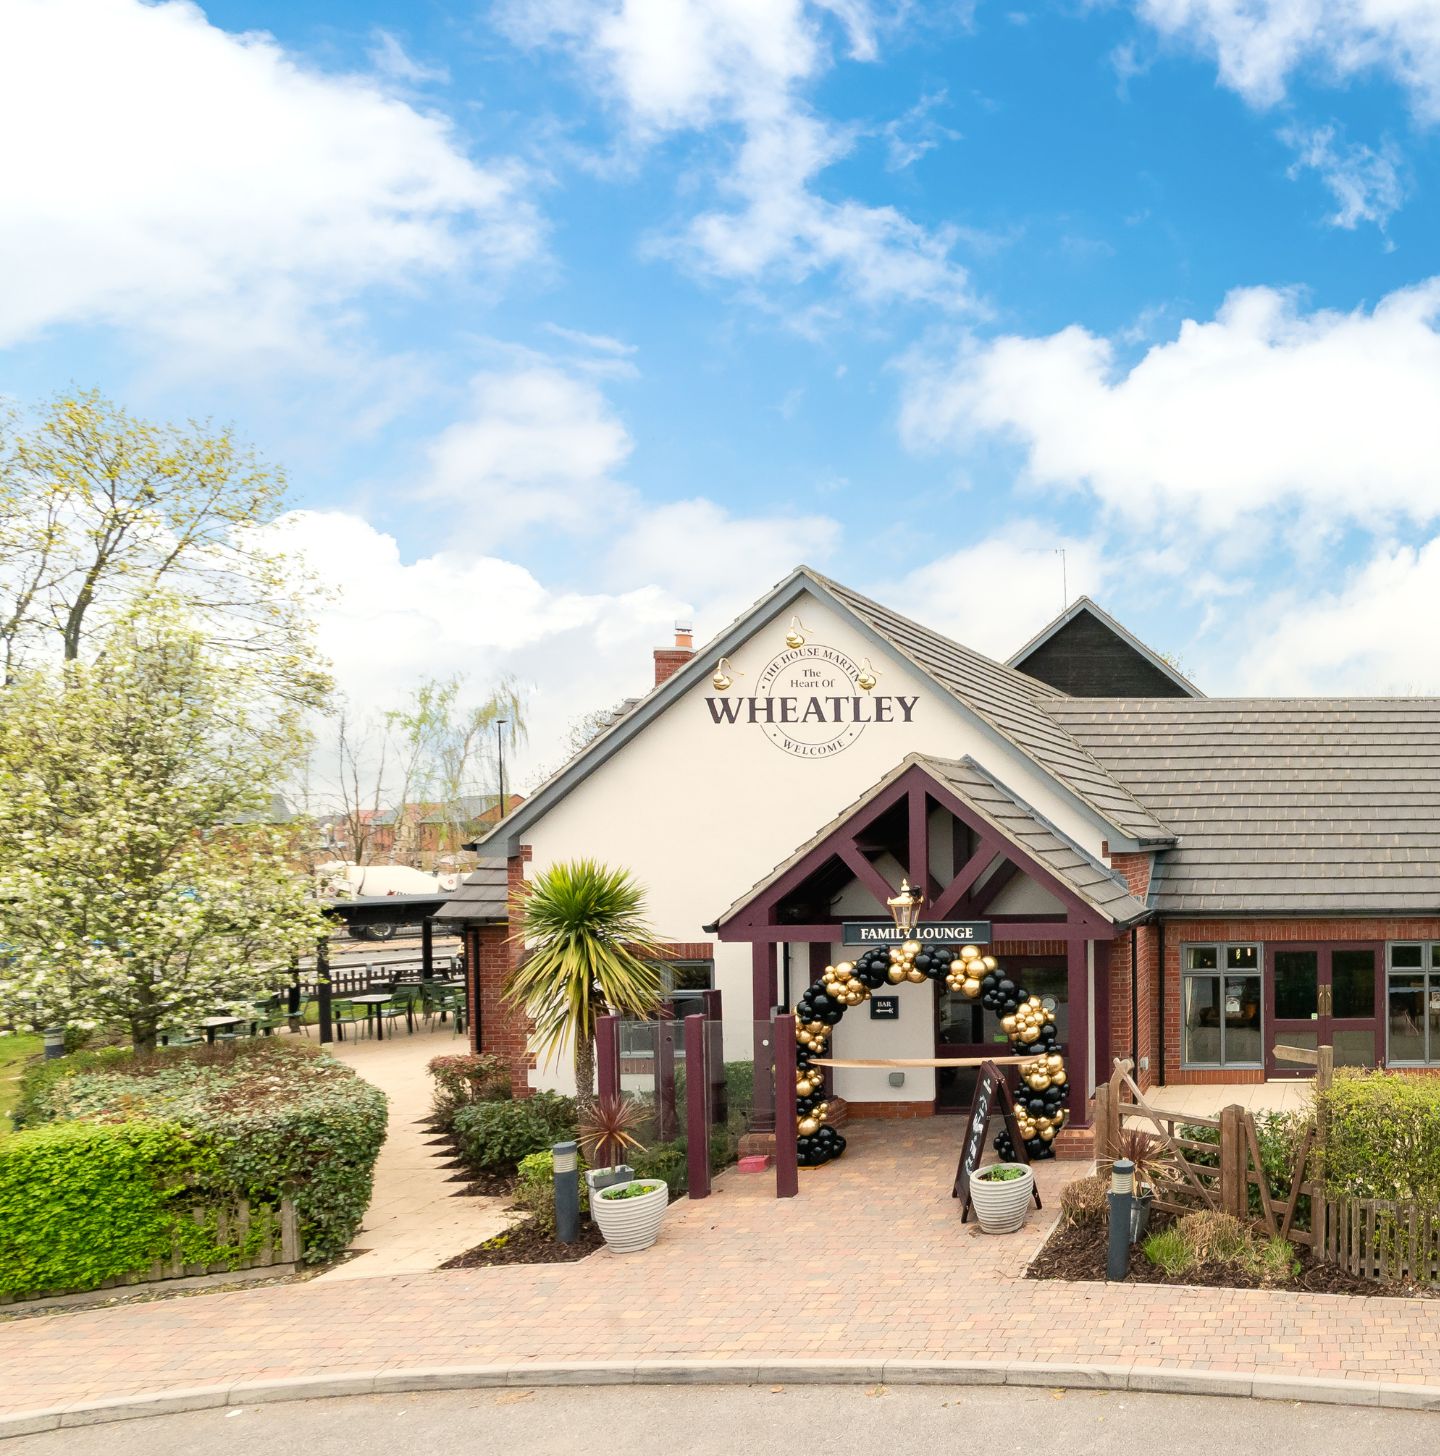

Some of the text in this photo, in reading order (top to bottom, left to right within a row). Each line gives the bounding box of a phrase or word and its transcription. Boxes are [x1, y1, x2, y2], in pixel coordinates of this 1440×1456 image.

[763, 648, 861, 682] THE HOUSE MARTIN
[802, 669, 821, 678] The
[790, 679, 836, 688] Heart Of
[705, 696, 920, 724] WHEATLEY
[783, 739, 845, 755] WELCOME
[860, 927, 973, 939] FAMILY LOUNGE
